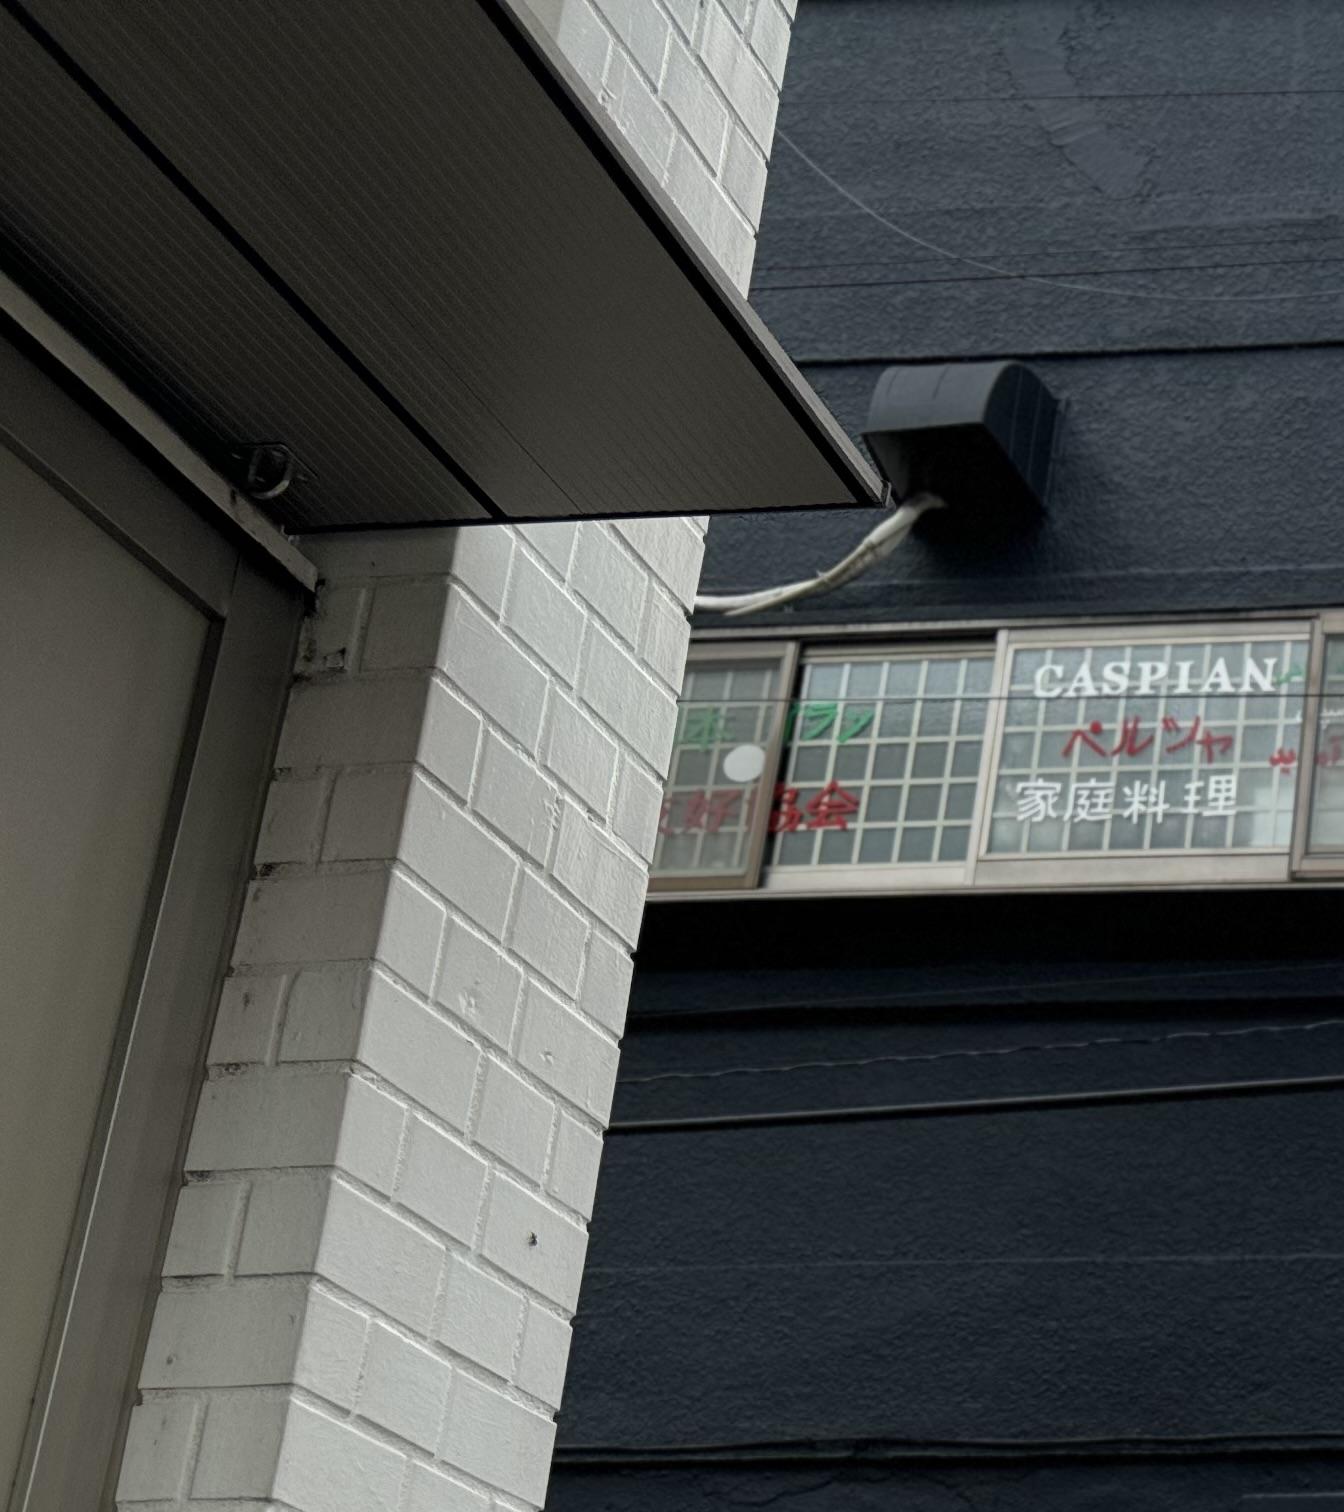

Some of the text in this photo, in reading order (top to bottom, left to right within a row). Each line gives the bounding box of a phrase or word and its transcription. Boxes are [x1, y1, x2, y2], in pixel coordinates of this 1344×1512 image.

[1034, 657, 1277, 698] CASPIAN
[1016, 774, 1238, 824] 家庭料理
